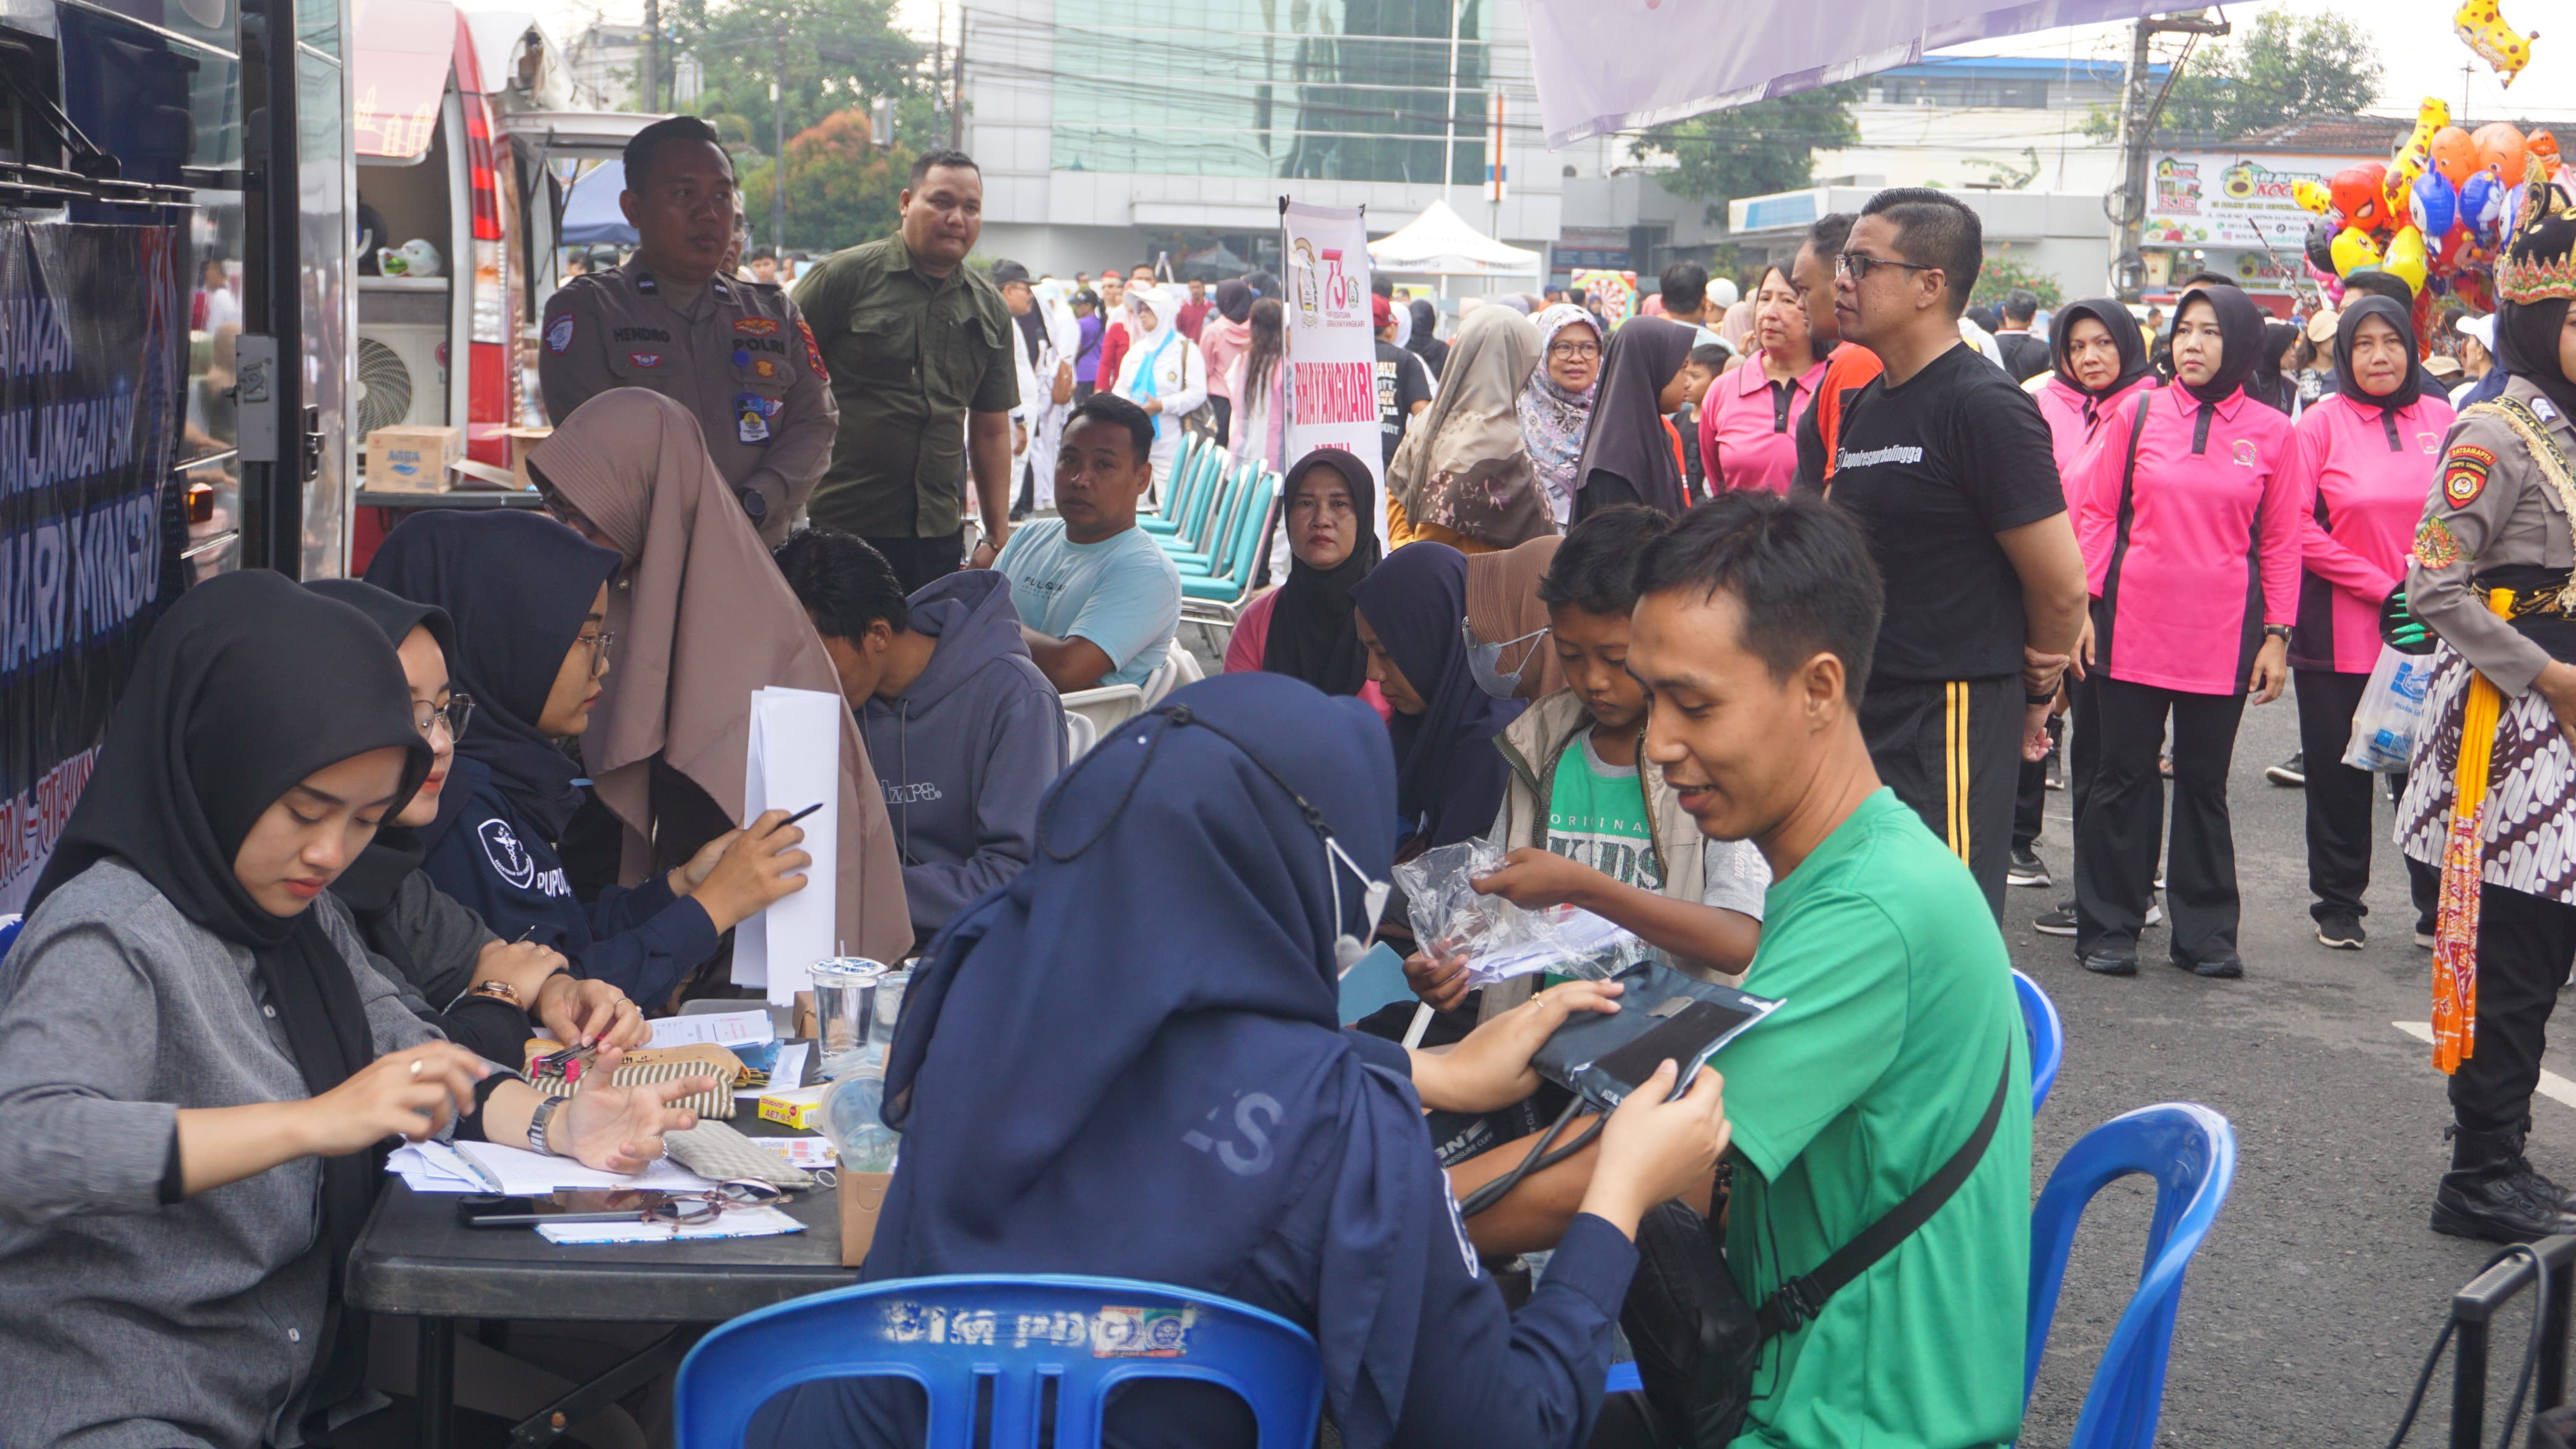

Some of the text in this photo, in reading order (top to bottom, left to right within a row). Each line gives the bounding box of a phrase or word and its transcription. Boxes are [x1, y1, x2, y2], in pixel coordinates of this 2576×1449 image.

[1321, 249, 1347, 310] 73
[614, 327, 671, 343] HENDRO
[733, 338, 786, 355] POLRI
[1295, 362, 1375, 425] BHAYANGKARI
[386, 450, 421, 463] AQUA
[2451, 446, 2492, 462] SATSAMAPTA
[1442, 1131, 1494, 1168] PRESSURE CUFF
